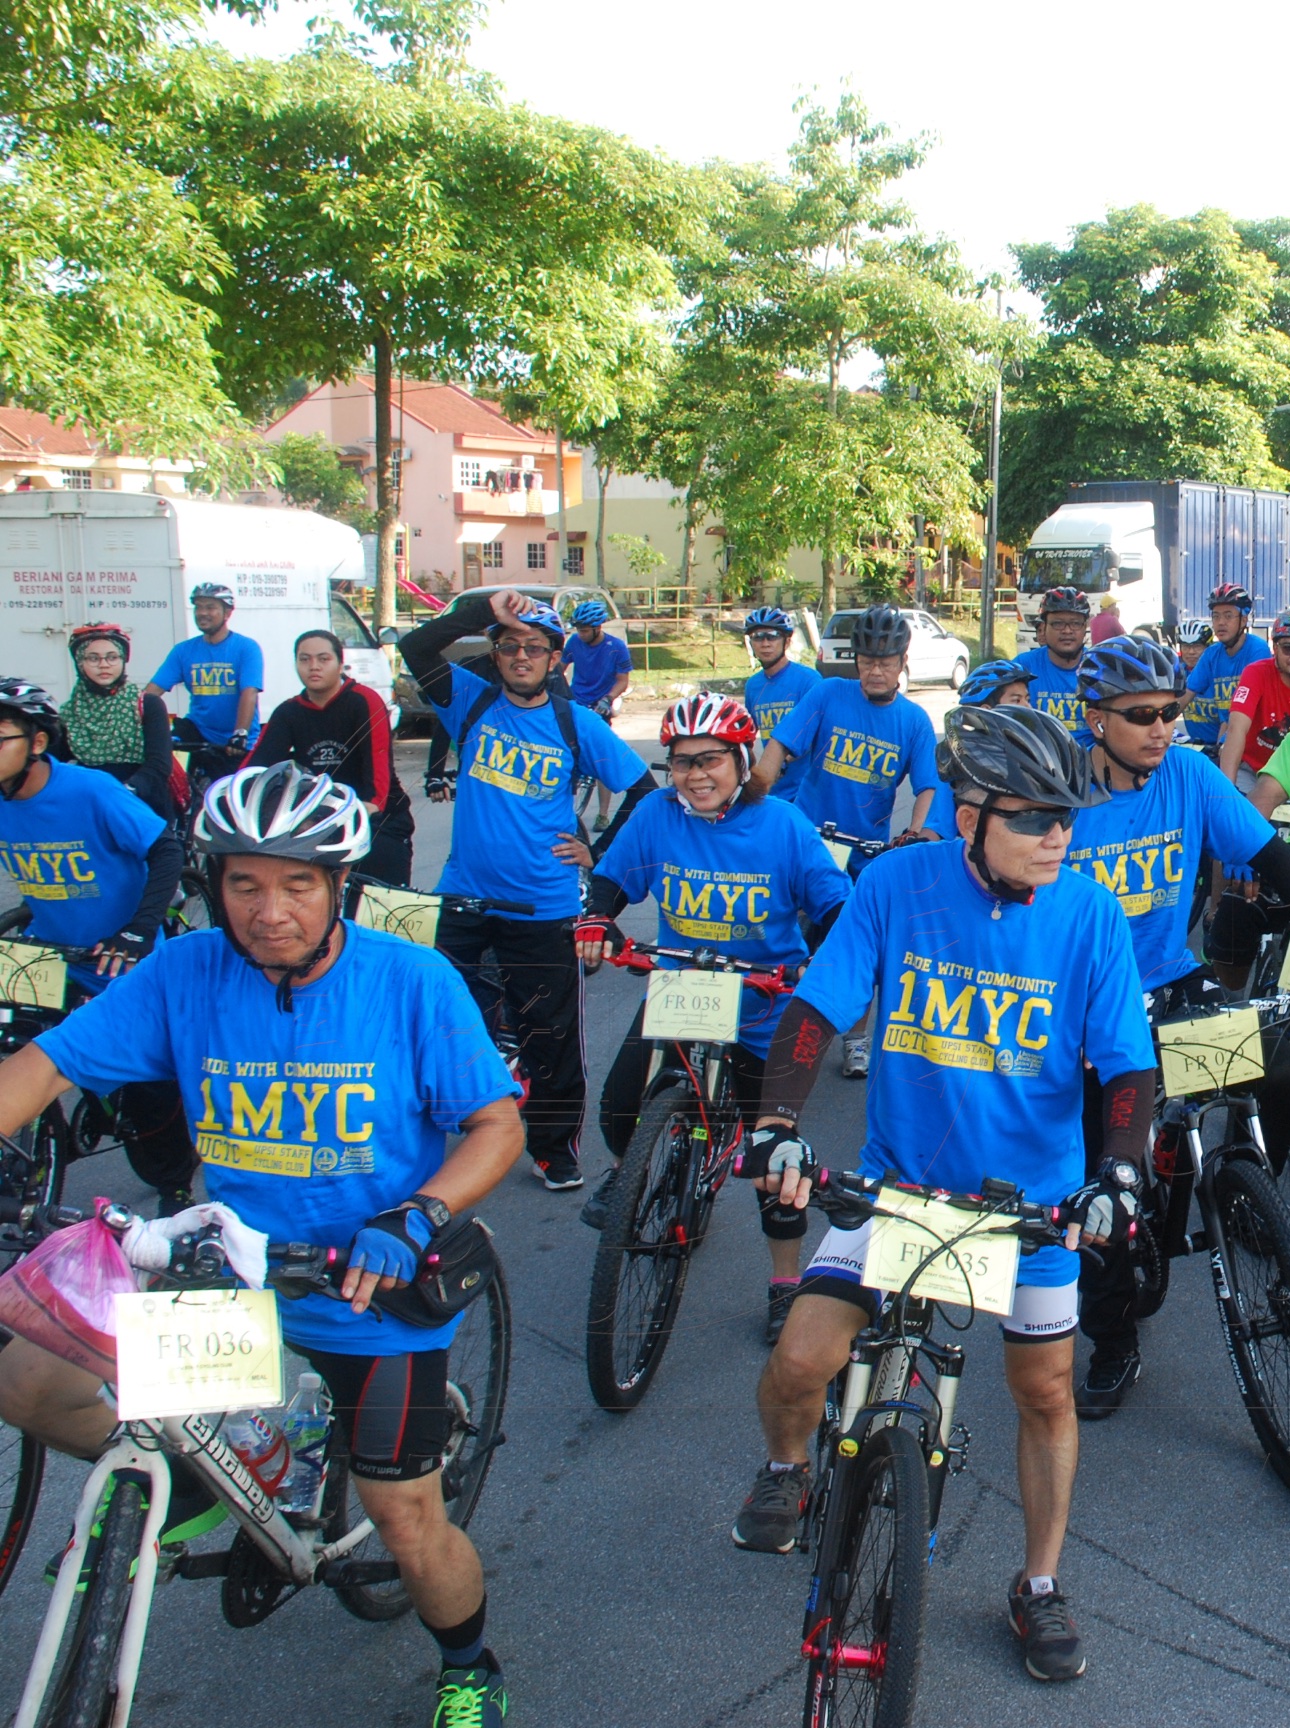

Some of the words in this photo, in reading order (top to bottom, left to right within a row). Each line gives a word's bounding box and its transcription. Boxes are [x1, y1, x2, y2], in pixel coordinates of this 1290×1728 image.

[13, 571, 63, 582] BERIANI
[100, 571, 137, 582] PRIMA
[19, 585, 63, 594] RESTORAN
[71, 586, 89, 594] DA
[90, 586, 132, 594] KATERING
[112, 601, 167, 609] 019-3908799
[191, 668, 236, 686] 1MYC
[1214, 681, 1240, 700] 1M
[519, 740, 564, 756] COMMUNITY
[866, 734, 901, 752] COMMUNITY
[320, 748, 334, 760] 23
[475, 735, 562, 786] 1MYC
[826, 735, 899, 777] 1MYC
[1069, 847, 1092, 860] RIDE
[1096, 842, 1124, 856] WITH
[1126, 828, 1182, 851] COMMUNTY
[0, 850, 95, 883] 1MYC
[663, 862, 680, 876] RIDE
[684, 868, 711, 880] WITH
[713, 871, 771, 884] COMMUNITY
[1071, 843, 1183, 894] MYC
[661, 876, 770, 923] 1MYC
[375, 914, 393, 927] FR
[709, 922, 730, 931] STAFF
[903, 951, 933, 972] RDE
[937, 962, 974, 981] WITH
[976, 970, 1057, 995] COMMUNITY
[664, 995, 685, 1009] FR
[692, 996, 721, 1011] 038
[889, 970, 1053, 1050] 1MYC
[887, 1028, 928, 1054] UCTC
[941, 1040, 962, 1051] UPSI
[965, 1044, 994, 1056] STAFF
[938, 1052, 968, 1064] CYCLING
[970, 1055, 989, 1067] CLUB
[1184, 1055, 1209, 1072] FR
[236, 1062, 277, 1077] WITH
[284, 1062, 375, 1078] CMMUNITY
[195, 1077, 375, 1143] 1MYC
[199, 1135, 241, 1164] UCTC
[254, 1145, 276, 1156] UPSI
[279, 1146, 310, 1159] STAFF
[253, 1158, 282, 1170] CYCLING
[285, 1161, 304, 1172] CLUB
[899, 1241, 935, 1267] FR
[945, 1249, 989, 1277] 035
[1024, 1317, 1073, 1332] SHIMANO
[158, 1334, 194, 1359] FR
[206, 1331, 253, 1357] 036
